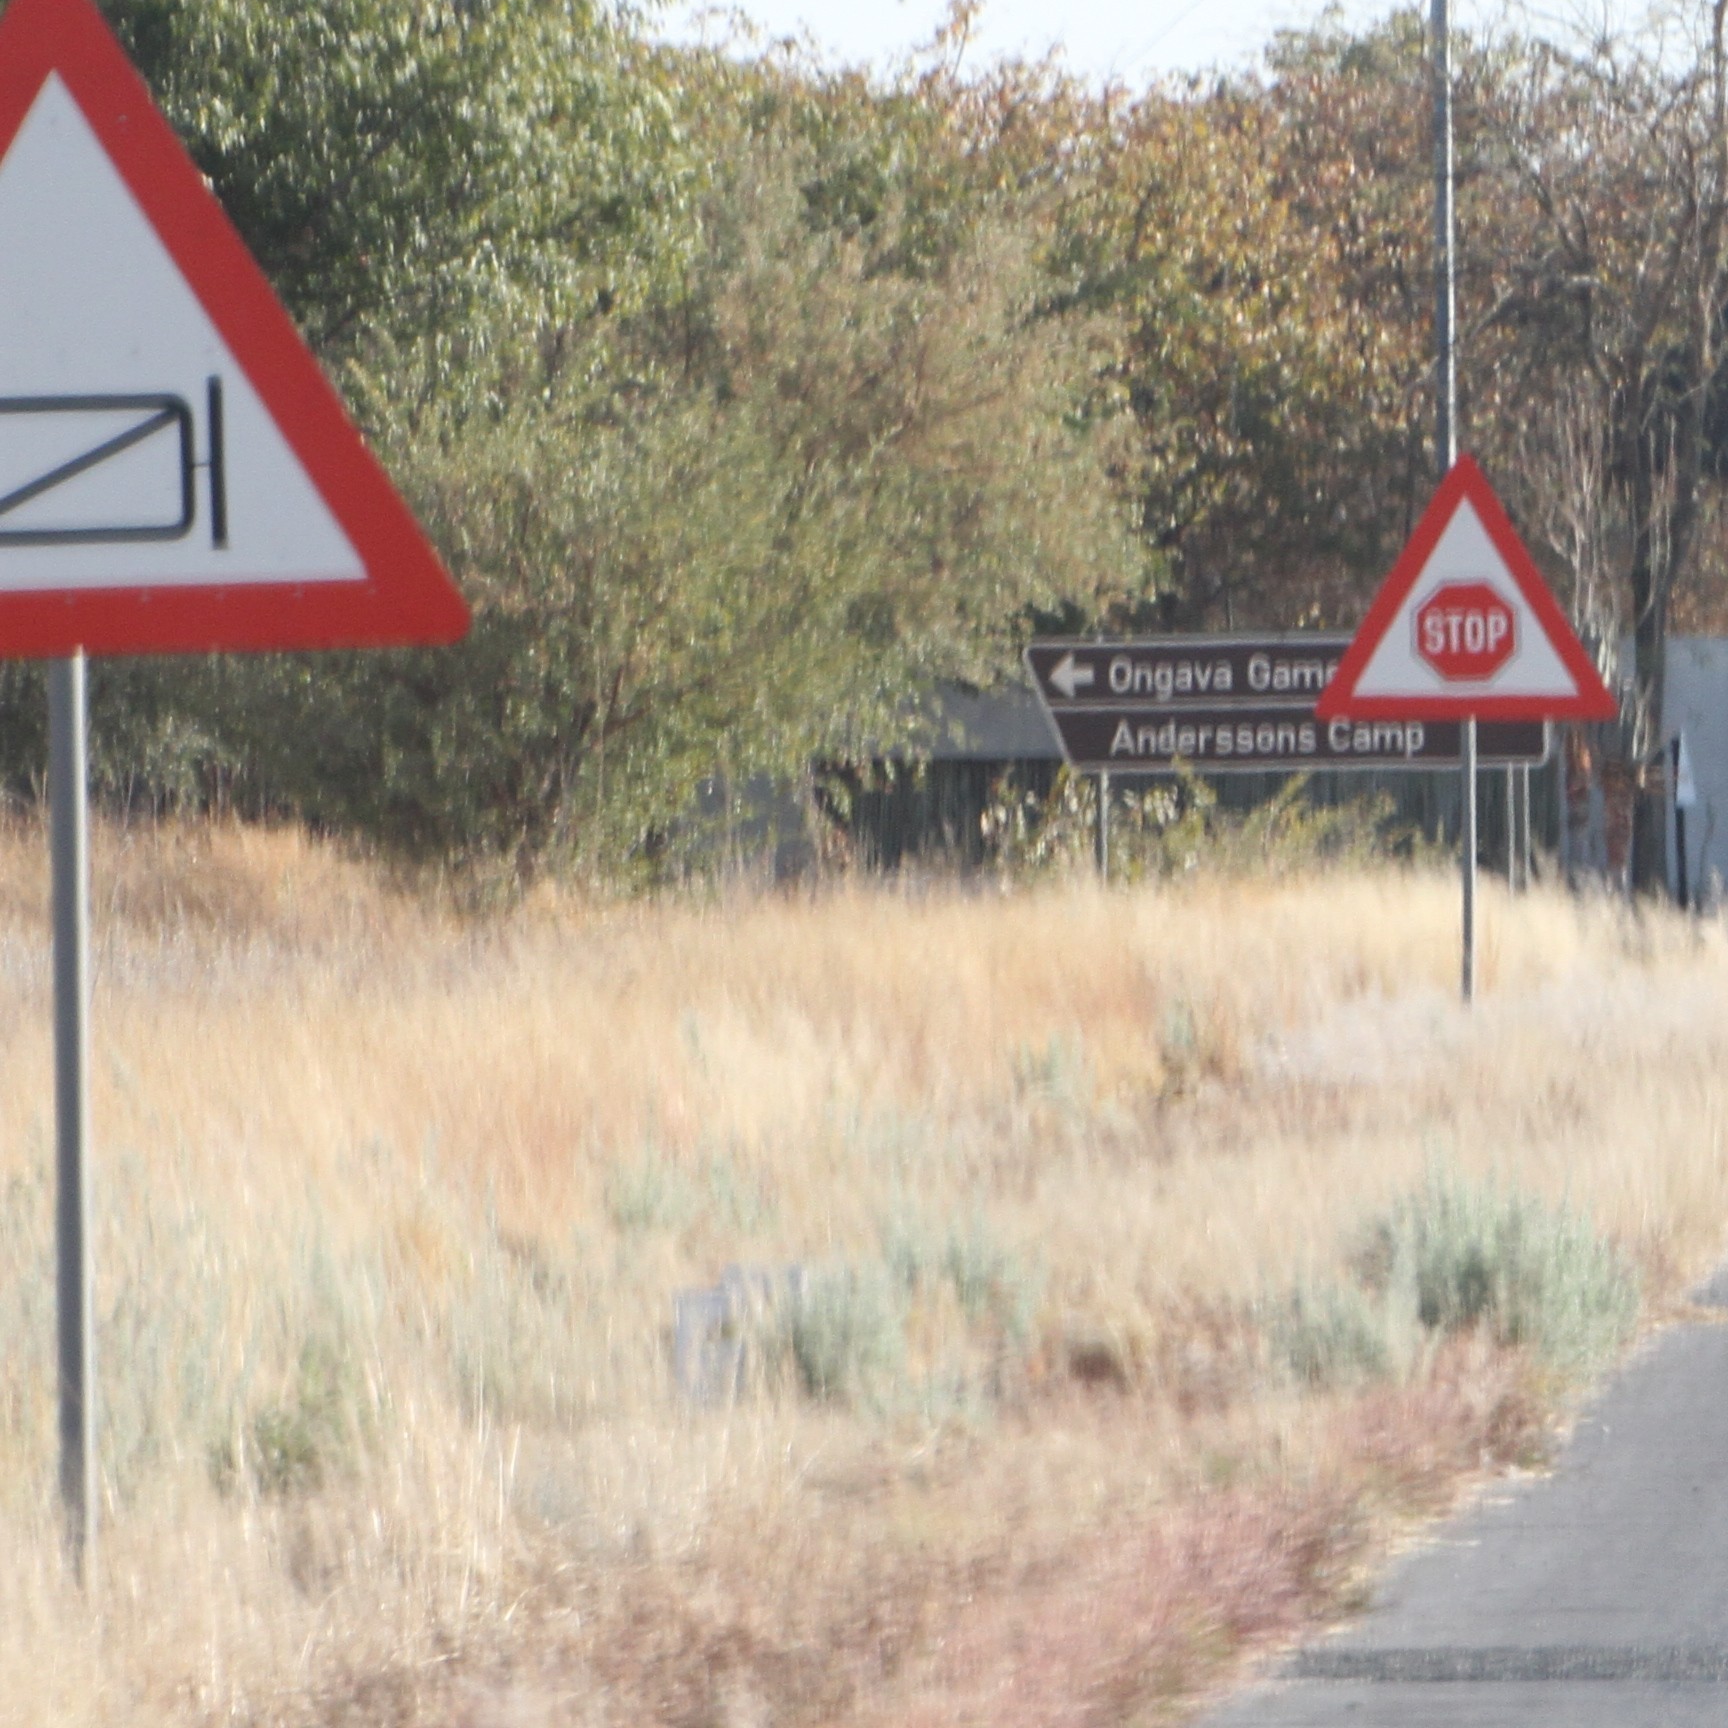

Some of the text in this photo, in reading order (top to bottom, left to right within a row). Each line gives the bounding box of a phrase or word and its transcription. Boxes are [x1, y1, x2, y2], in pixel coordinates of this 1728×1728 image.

[1423, 607, 1508, 655] STOP
[1109, 655, 1233, 702] Ongava
[1109, 716, 1425, 758] Anderssons Camp
